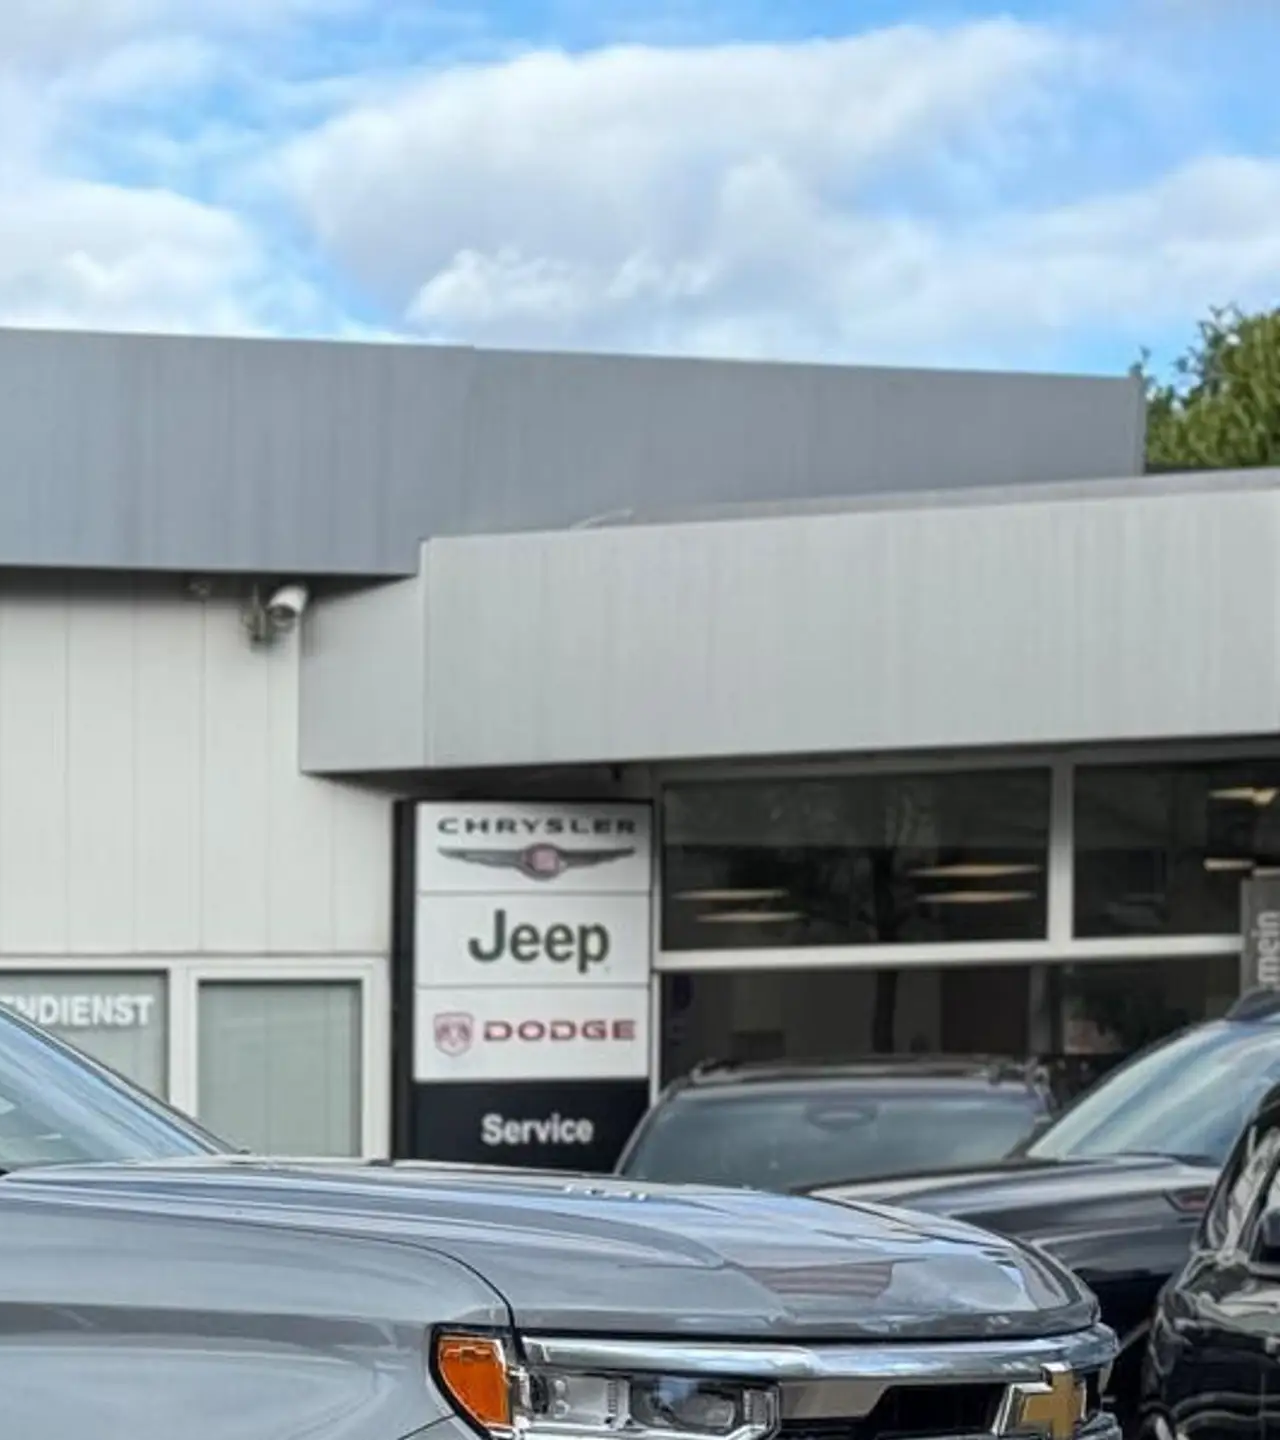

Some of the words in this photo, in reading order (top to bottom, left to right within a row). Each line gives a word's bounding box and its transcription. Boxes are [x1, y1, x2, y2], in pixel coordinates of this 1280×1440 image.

[437, 817, 637, 834] CHRYSLER
[468, 909, 610, 974] Jeep
[483, 1020, 636, 1042] DODGE
[481, 1113, 595, 1145] Service
